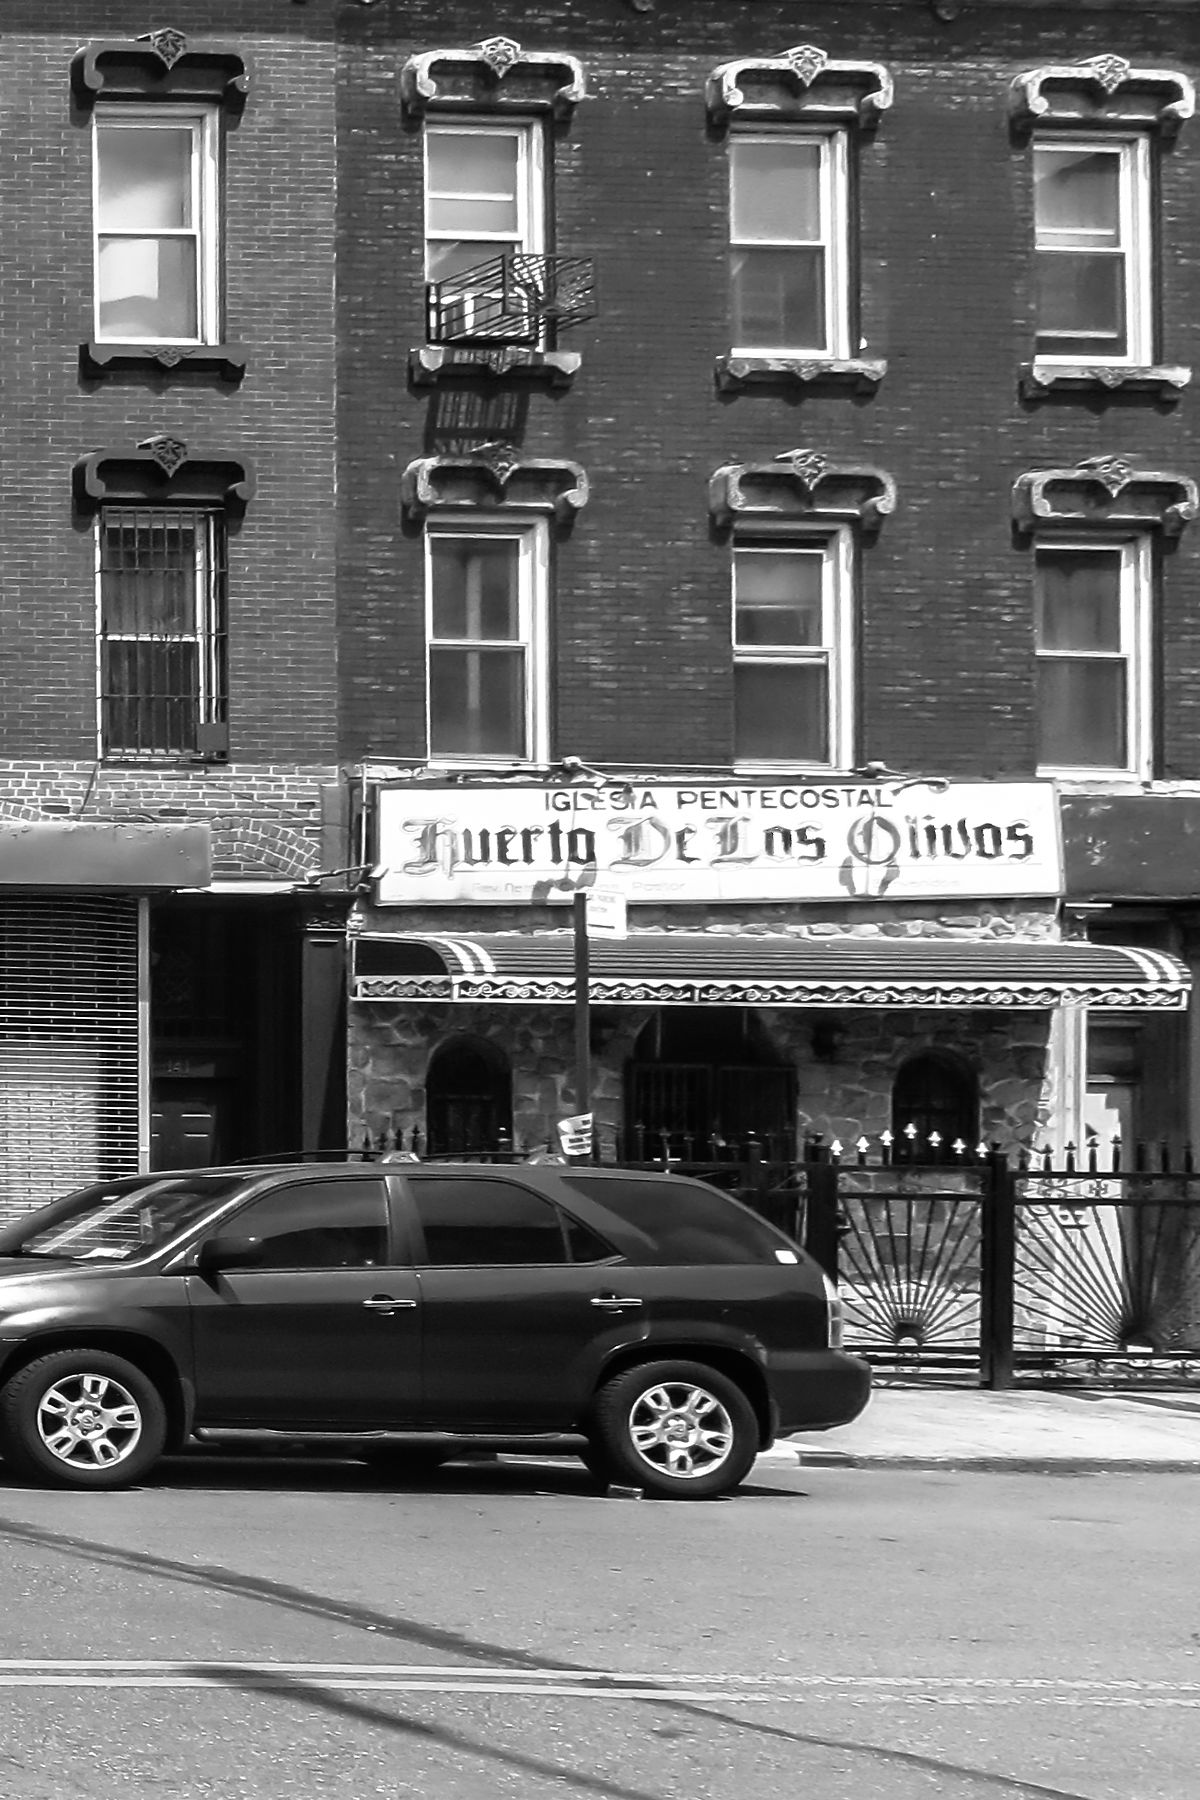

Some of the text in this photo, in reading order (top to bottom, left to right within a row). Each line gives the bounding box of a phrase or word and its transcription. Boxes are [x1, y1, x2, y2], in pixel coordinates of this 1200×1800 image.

[545, 788, 894, 812] IGLESIA PENTECOSTAL
[401, 814, 1035, 878] Huerto De Los Olivos
